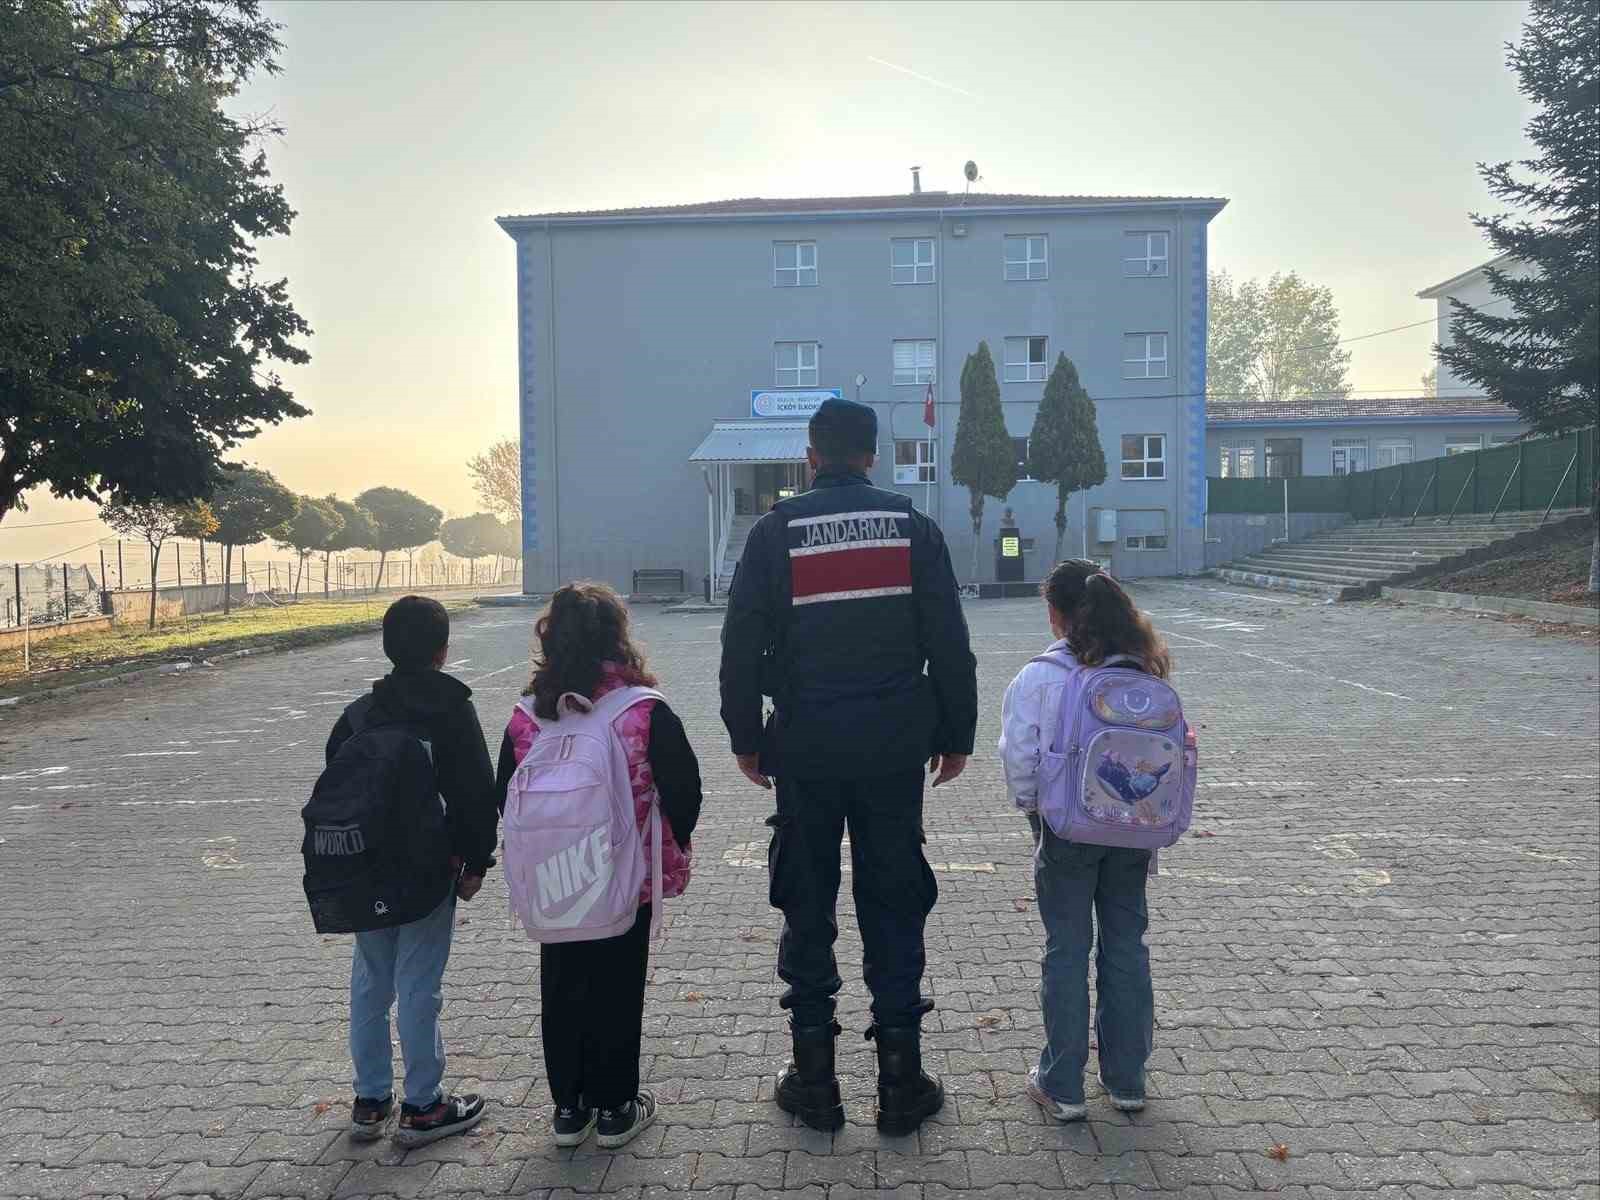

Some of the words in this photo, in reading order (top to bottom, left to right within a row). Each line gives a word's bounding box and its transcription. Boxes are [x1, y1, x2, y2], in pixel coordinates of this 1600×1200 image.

[800, 518, 901, 547] JANDARMA
[314, 830, 367, 856] WORLD
[535, 825, 611, 911] NIKE
